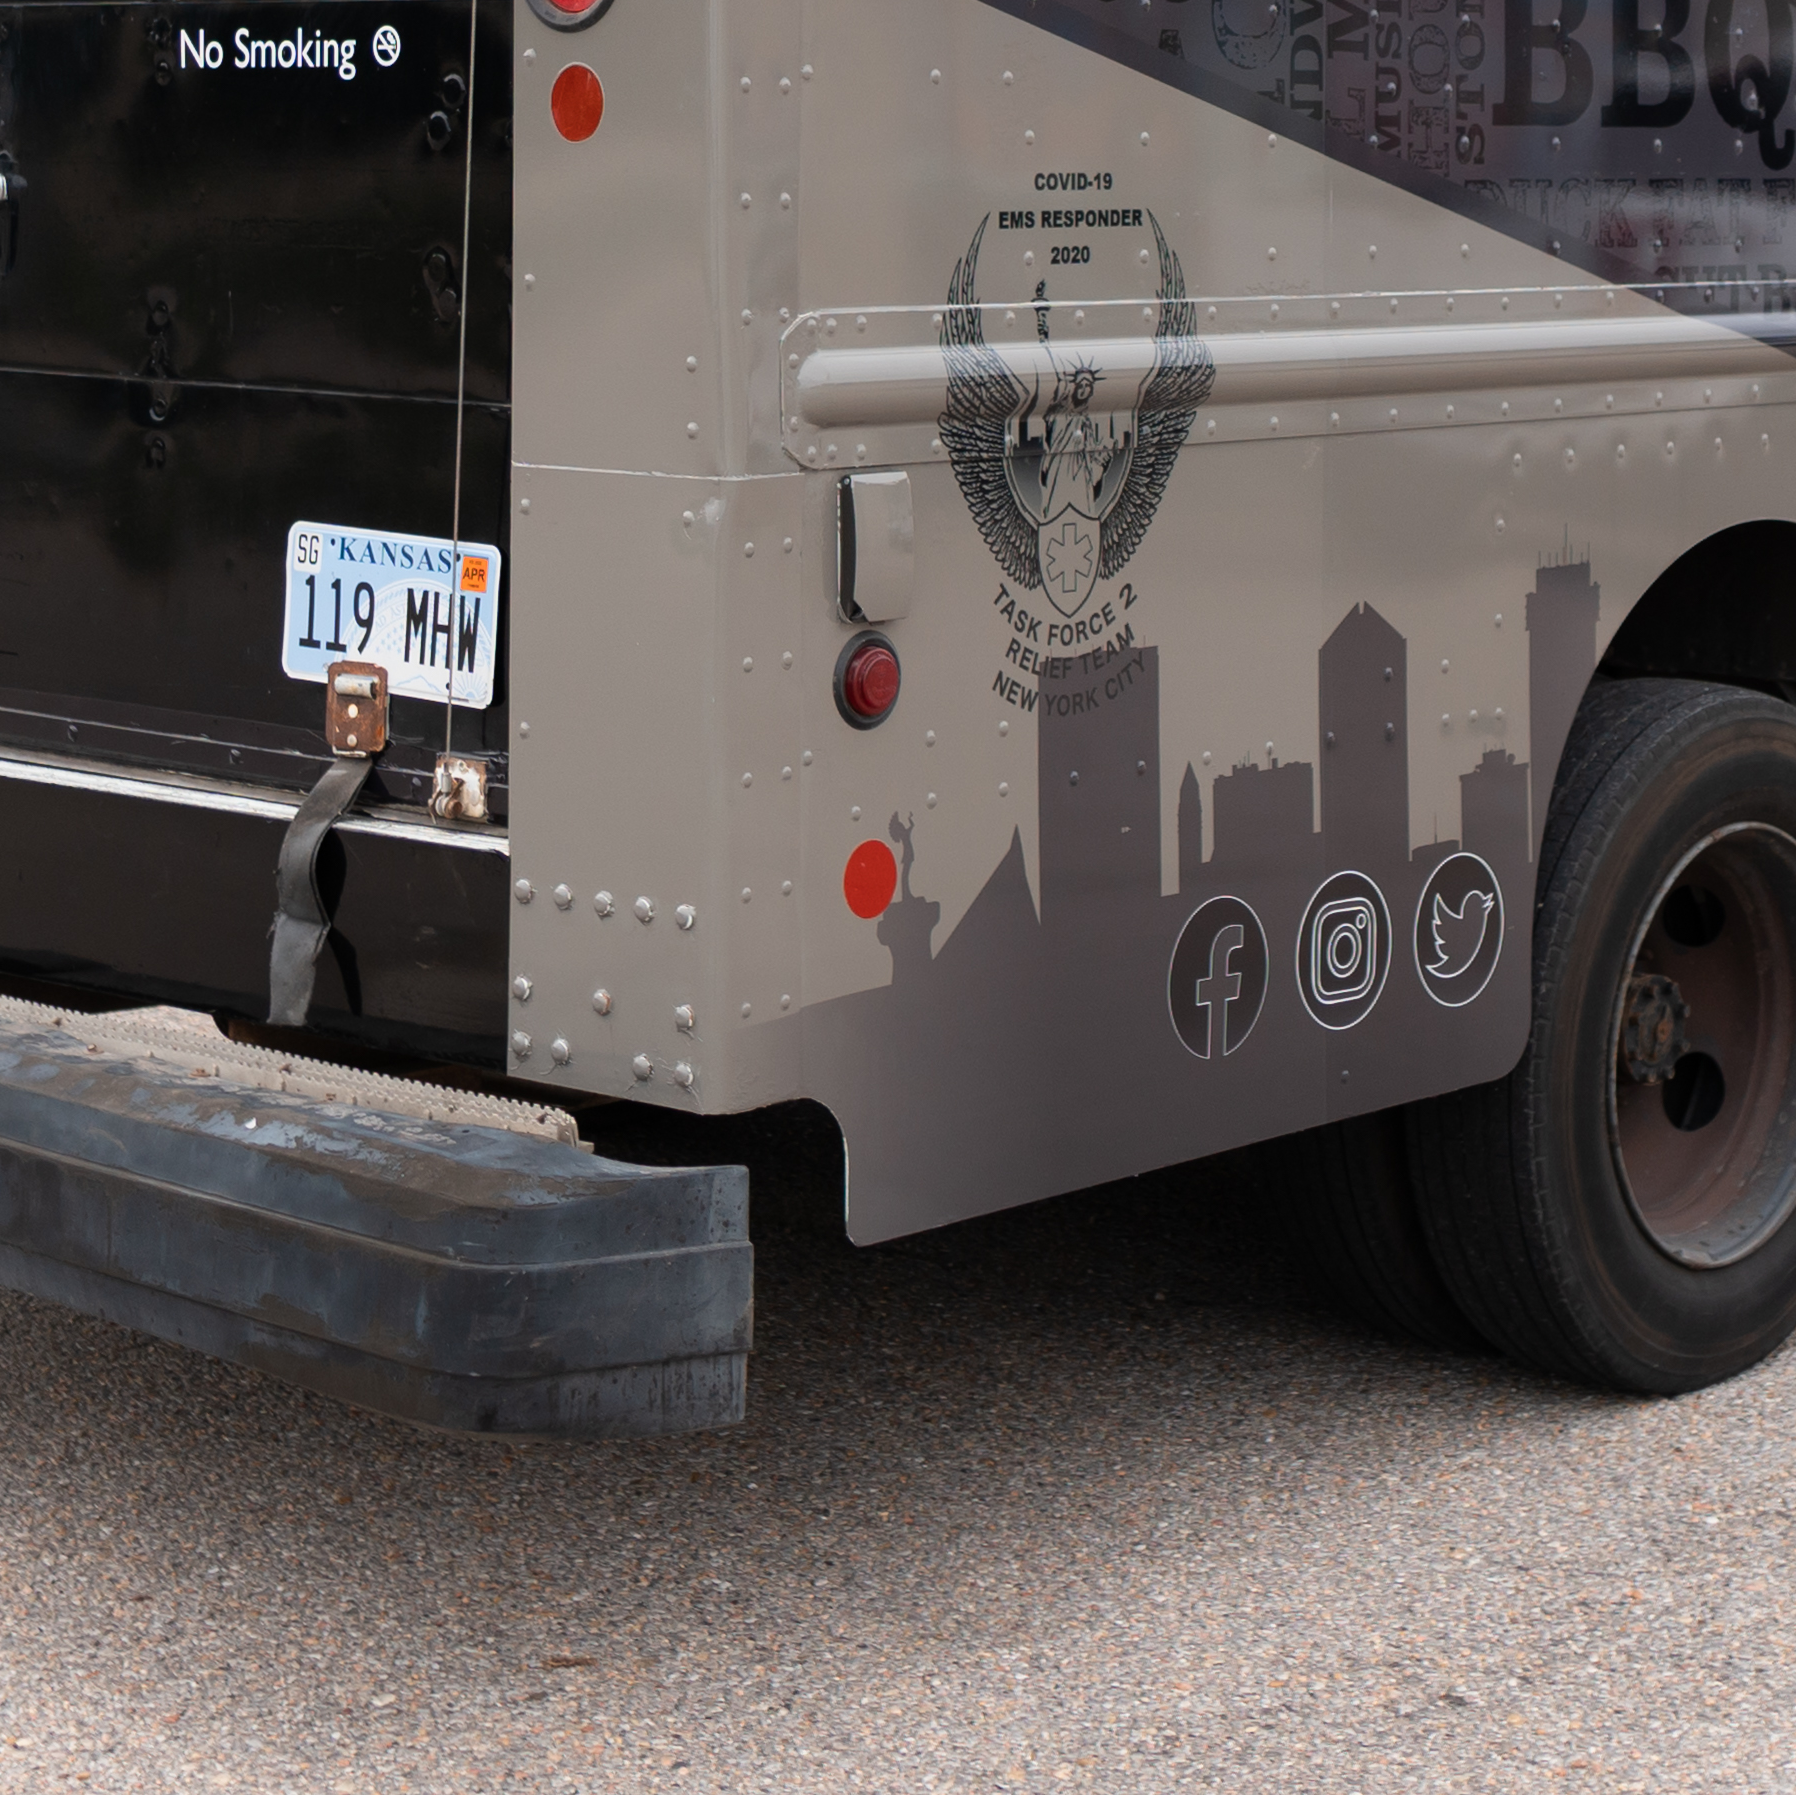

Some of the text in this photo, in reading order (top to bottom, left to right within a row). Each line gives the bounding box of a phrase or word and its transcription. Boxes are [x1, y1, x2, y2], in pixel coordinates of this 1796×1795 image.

[180, 27, 357, 81] No Smoking
[1034, 172, 1113, 191] COVID-19
[998, 208, 1143, 229] EMS RESPONDER
[1050, 245, 1091, 265] 2020
[298, 534, 320, 565] SG
[338, 536, 453, 574] KANSAS
[462, 567, 486, 582] APR
[299, 574, 481, 673] 119 MHW
[993, 583, 1138, 646] TASK FORCE 2
[1006, 622, 1135, 680] RELIEF TEAM
[992, 651, 1145, 717] NEW YORK CITY
